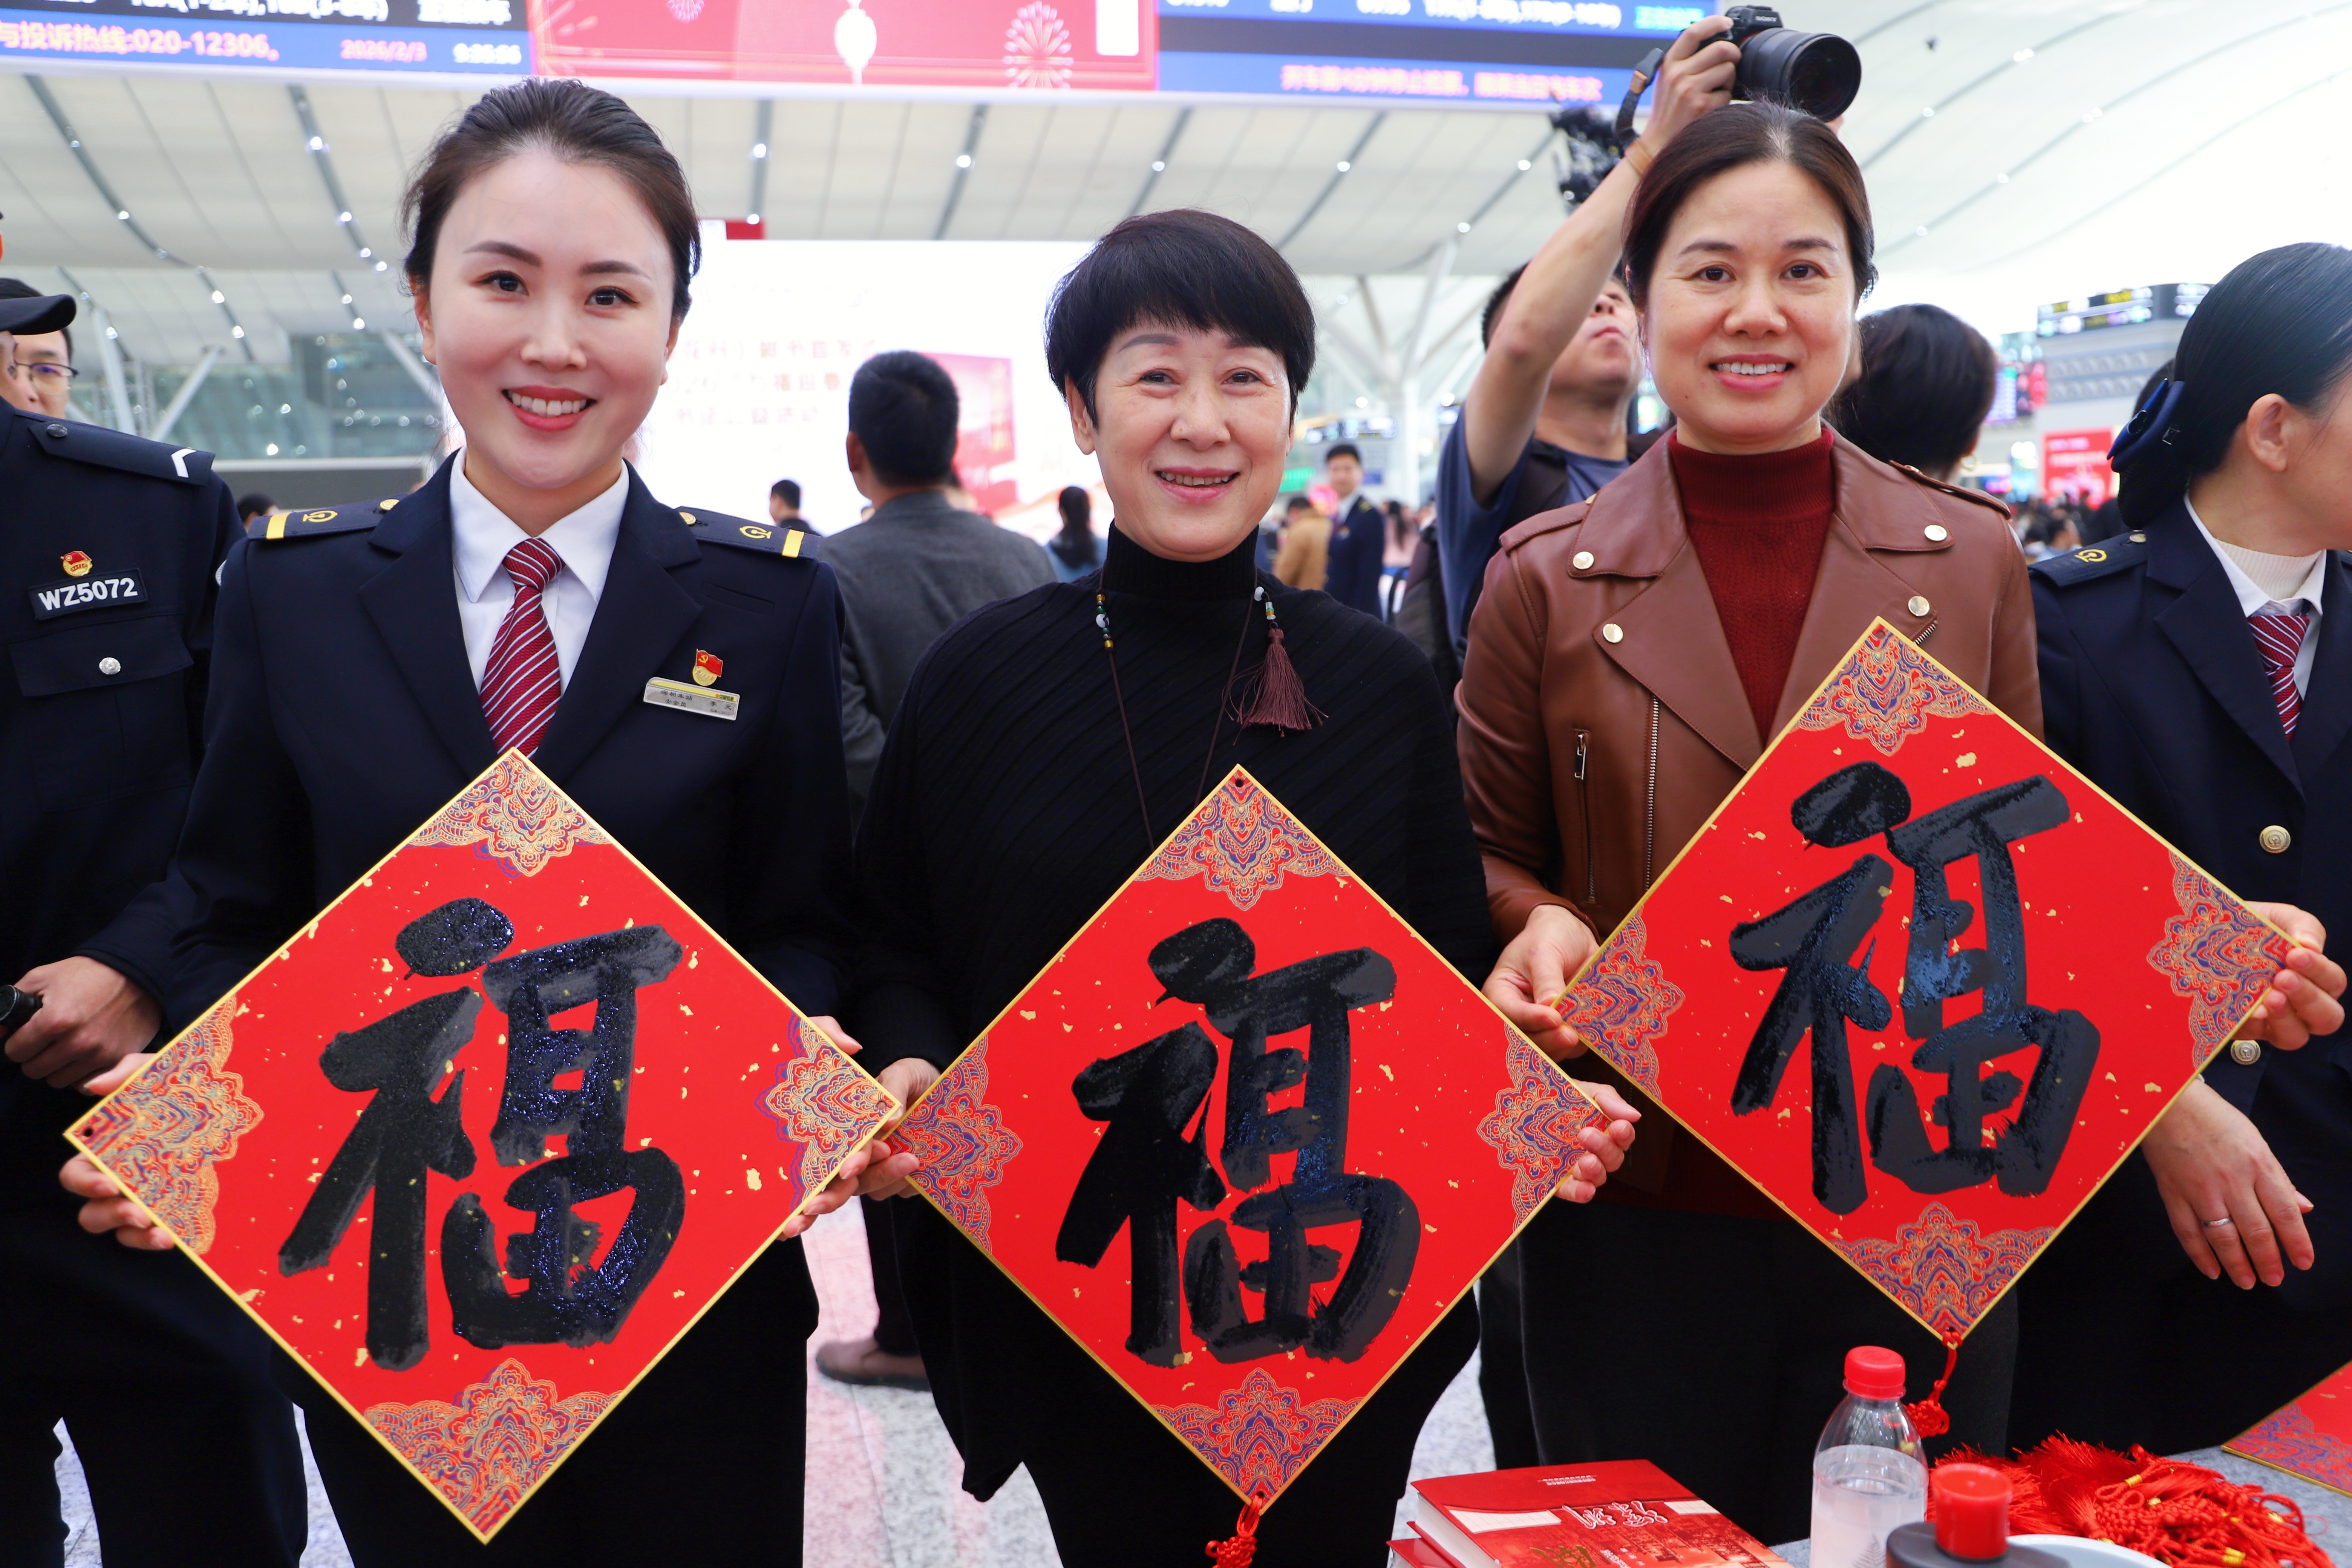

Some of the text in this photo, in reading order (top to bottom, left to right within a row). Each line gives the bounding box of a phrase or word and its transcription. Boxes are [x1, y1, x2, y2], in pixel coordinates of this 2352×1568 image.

[340, 39, 427, 63] 2026/2/3
[38, 577, 138, 611] WZ5072
[665, 699, 686, 707] 安全员
[1729, 761, 2101, 1214] 福
[278, 897, 685, 1371] 福
[1056, 917, 1421, 1369] 福
